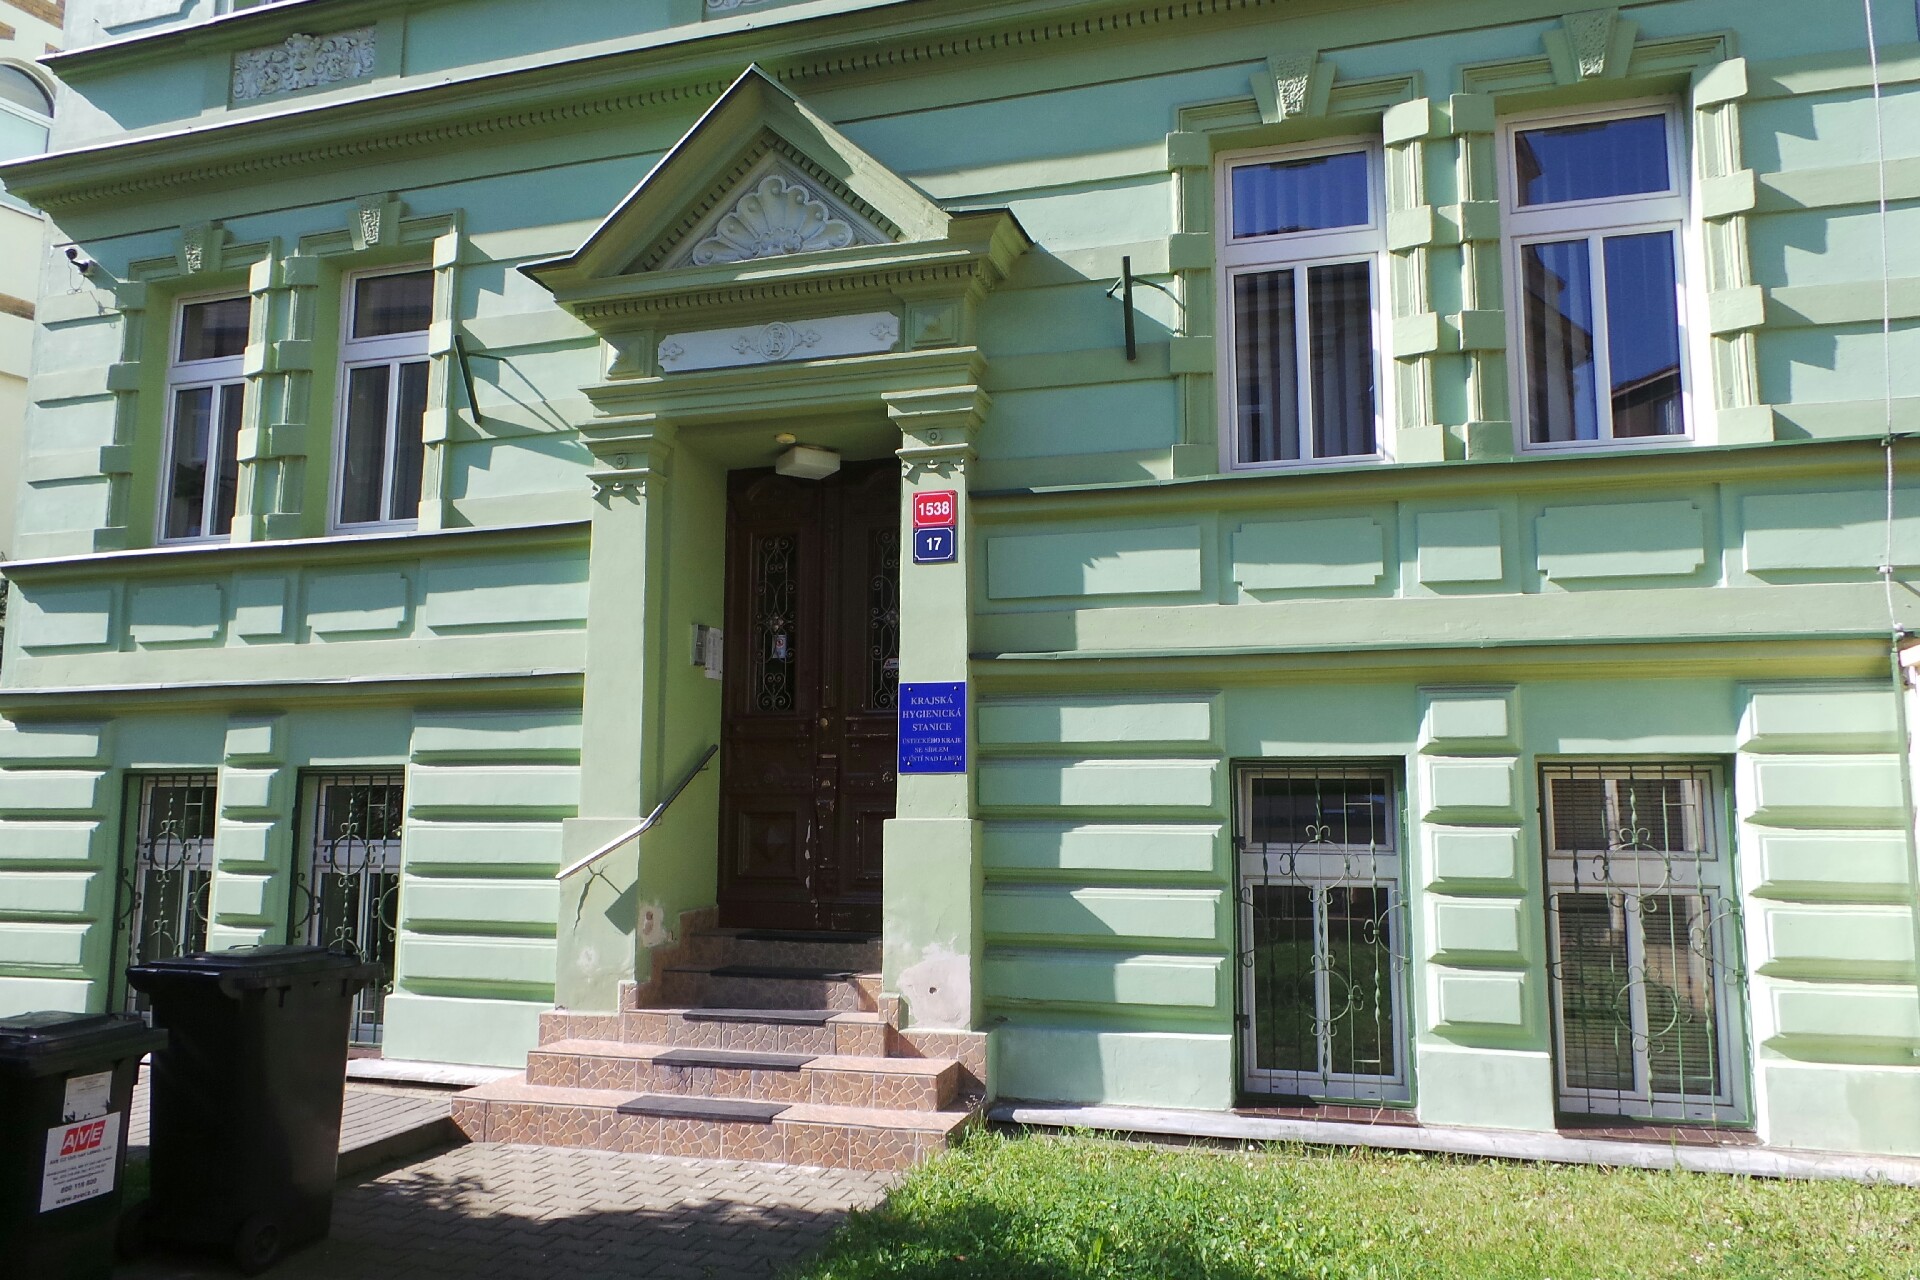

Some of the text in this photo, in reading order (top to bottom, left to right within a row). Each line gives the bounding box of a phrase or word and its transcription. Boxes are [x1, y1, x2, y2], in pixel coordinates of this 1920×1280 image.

[918, 501, 950, 516] 1538
[926, 537, 942, 551] 17
[910, 694, 954, 705] KRAJSKÁ
[902, 708, 962, 719] HYGIENICKÁ
[912, 722, 952, 732] STANICE
[924, 745, 949, 753] SÍDLEM
[62, 1126, 104, 1149] AVE
